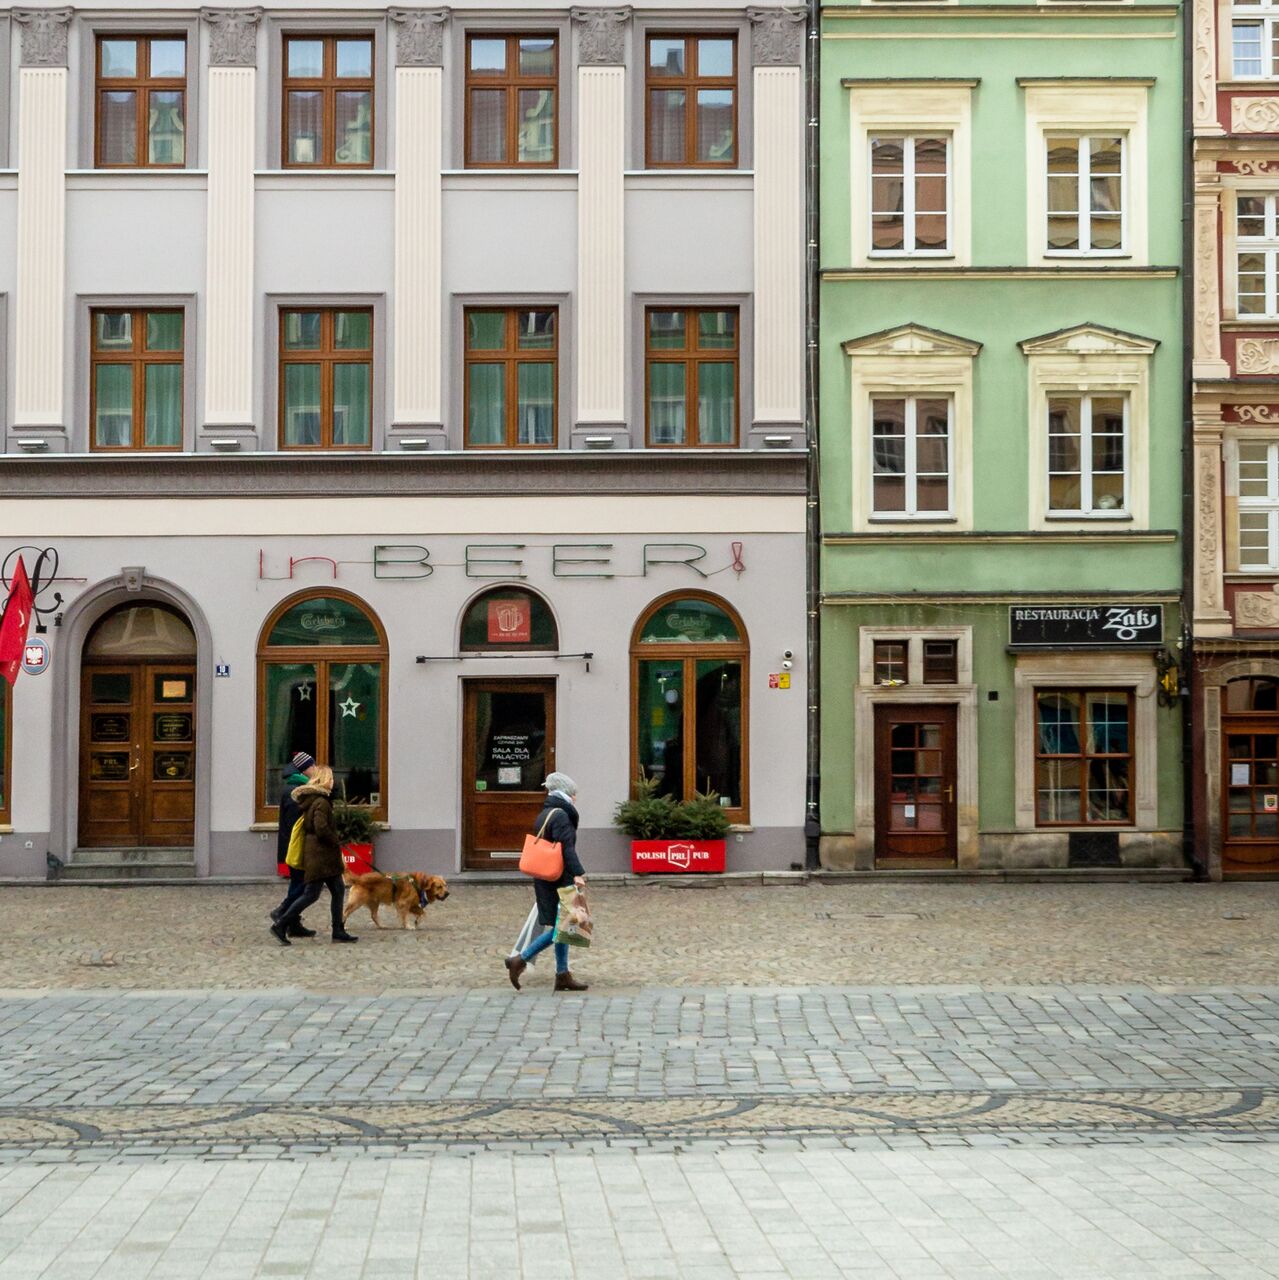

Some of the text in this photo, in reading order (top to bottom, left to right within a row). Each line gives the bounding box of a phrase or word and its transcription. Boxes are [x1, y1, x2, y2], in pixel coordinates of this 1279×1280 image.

[260, 548, 337, 580] In
[1015, 608, 1099, 622] RESTAURACJA
[635, 851, 709, 860] POLISH PRL PUB
